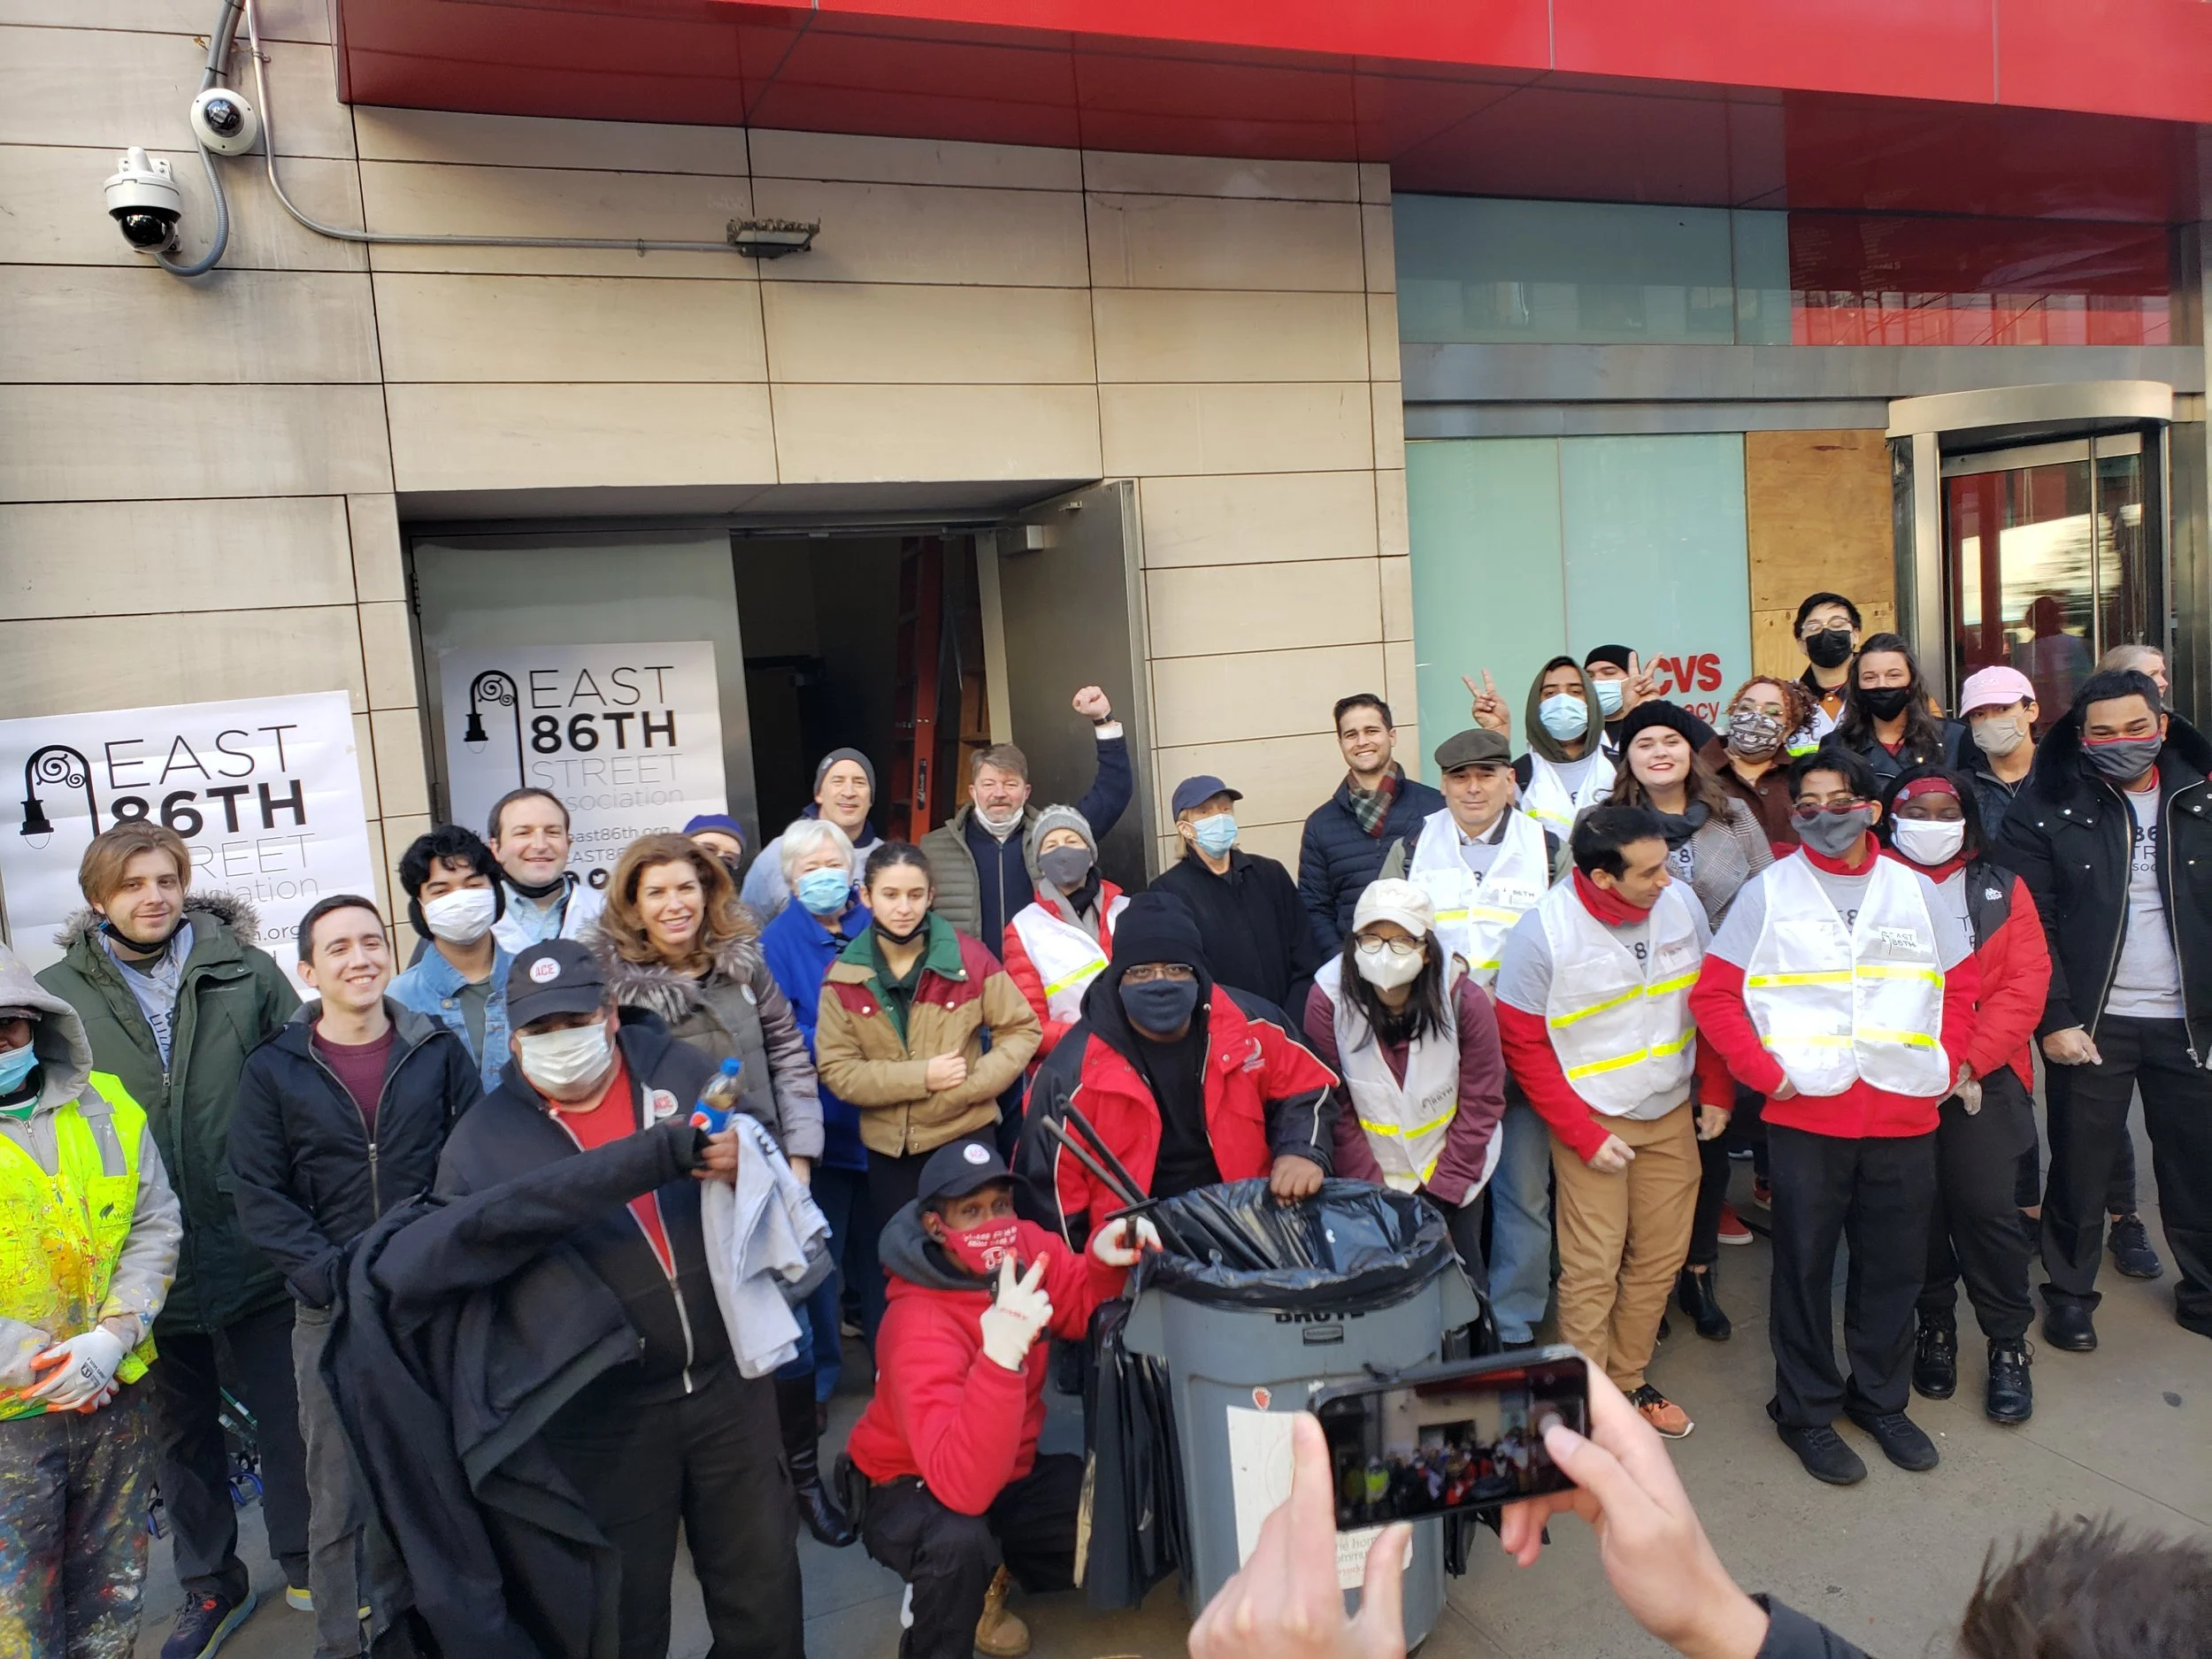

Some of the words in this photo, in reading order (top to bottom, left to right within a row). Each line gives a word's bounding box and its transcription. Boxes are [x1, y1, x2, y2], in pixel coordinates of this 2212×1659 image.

[529, 665, 674, 709] EAST
[1652, 653, 1723, 696] CVS
[532, 710, 677, 754] 86TH
[104, 724, 298, 789] EAST
[532, 753, 683, 790] STREET
[111, 779, 306, 839] 86TH
[557, 788, 685, 812] sociation
[188, 833, 316, 879] REET
[535, 964, 556, 977] ACE
